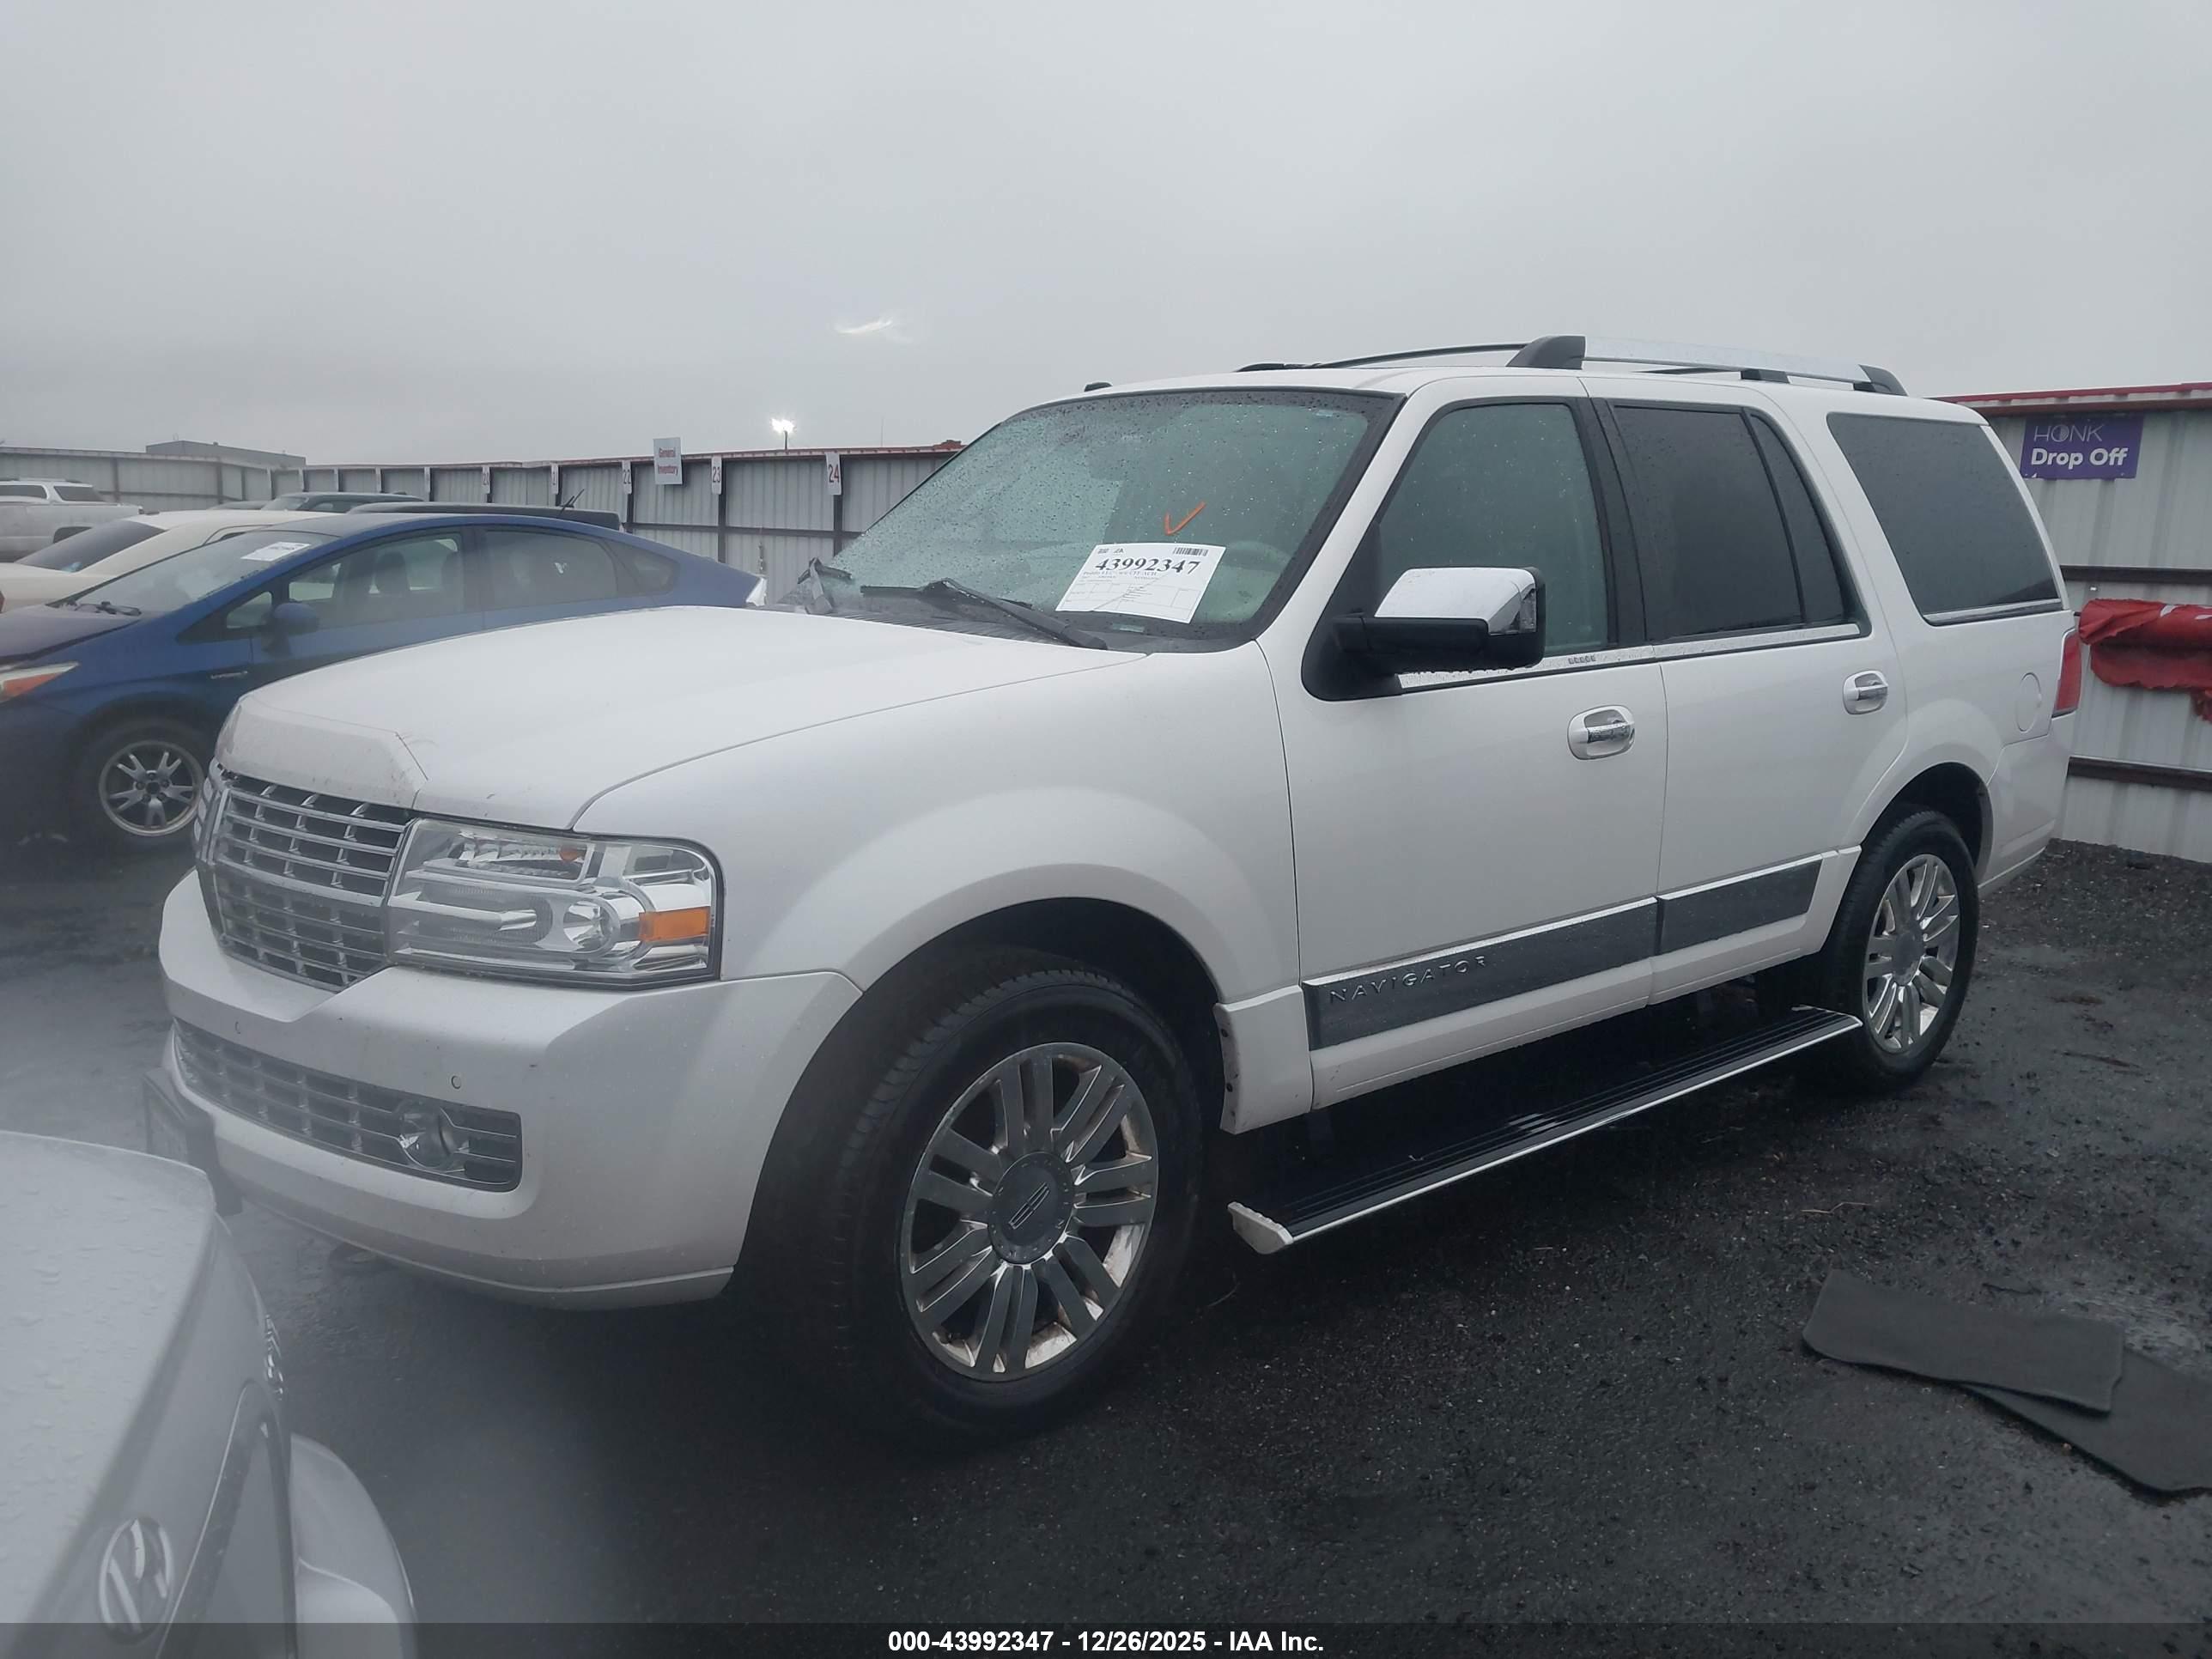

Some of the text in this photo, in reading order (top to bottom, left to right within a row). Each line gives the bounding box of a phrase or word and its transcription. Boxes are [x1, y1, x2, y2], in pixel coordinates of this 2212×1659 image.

[2033, 424, 2104, 442] HONK
[2031, 447, 2129, 470] Drop Off
[623, 469, 631, 484] 22
[712, 466, 721, 483] 23
[829, 464, 840, 483] 24
[1095, 557, 1201, 574] 43992347
[1331, 956, 1486, 1002] NAVIGATOR
